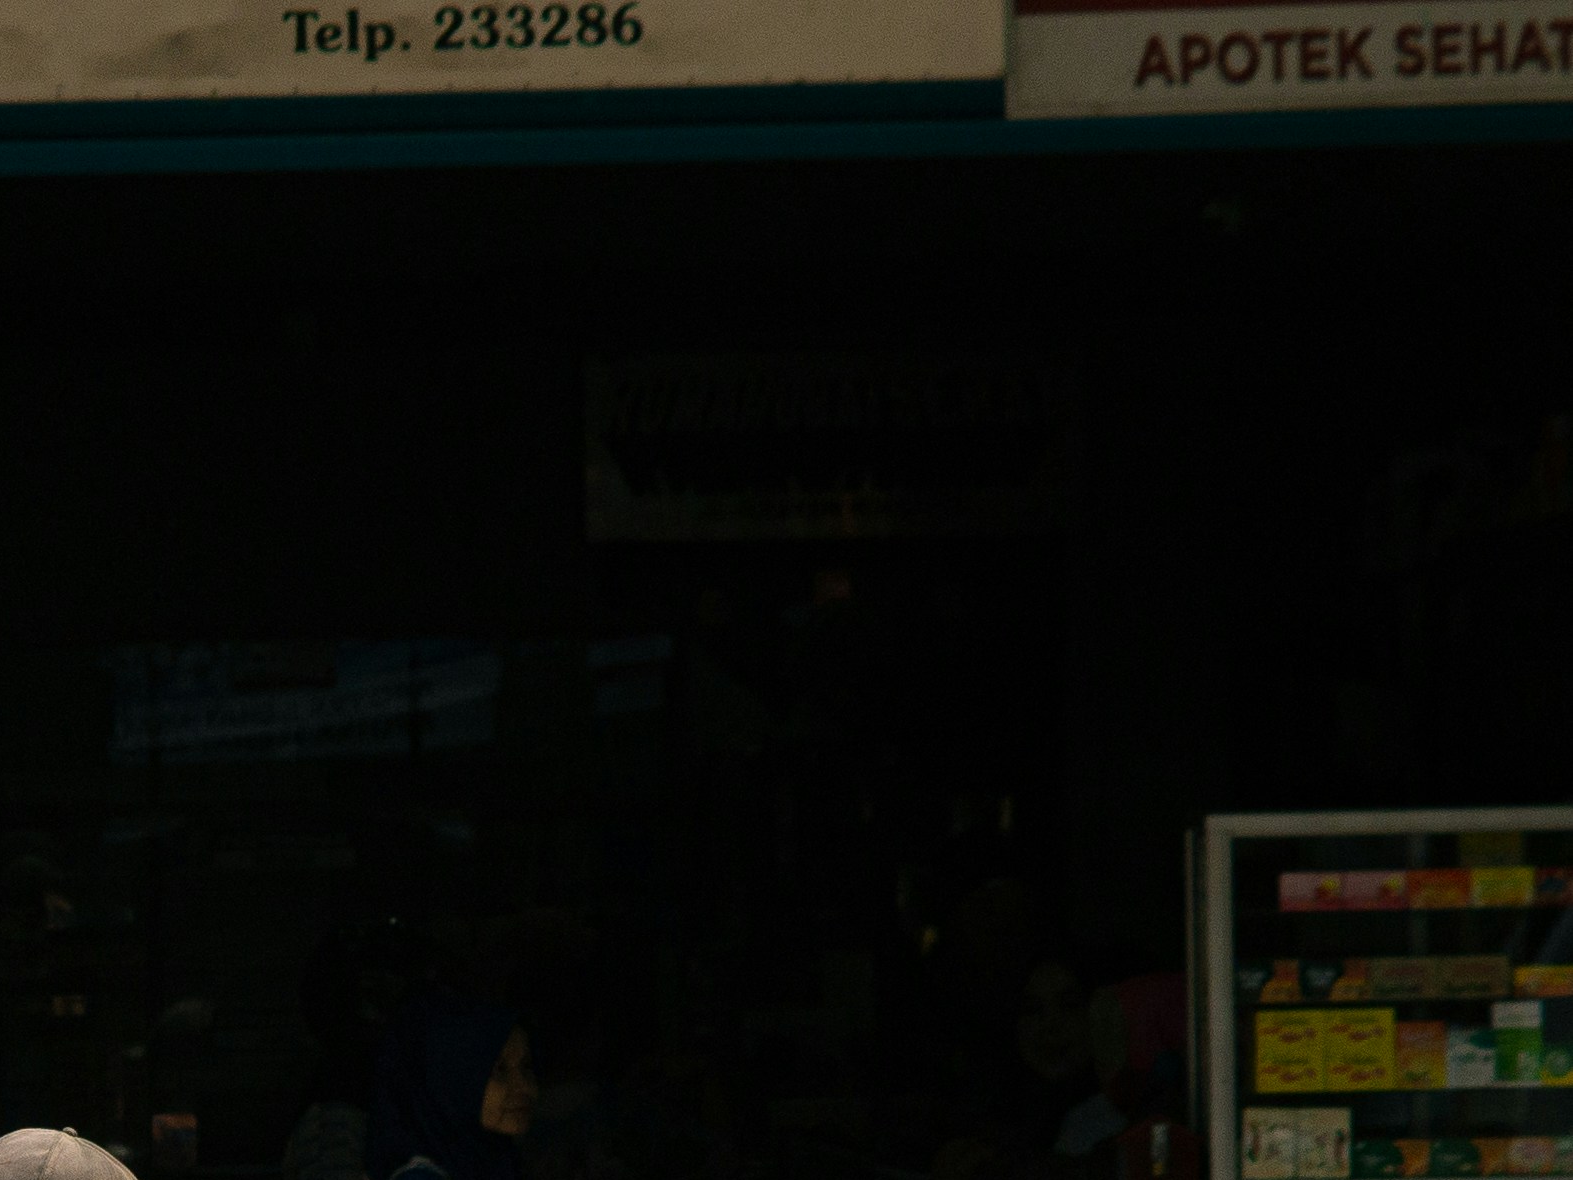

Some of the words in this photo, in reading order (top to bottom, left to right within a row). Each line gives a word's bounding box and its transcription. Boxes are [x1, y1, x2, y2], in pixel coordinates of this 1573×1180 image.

[282, 9, 410, 61] Telp.
[435, 4, 643, 50] 233286
[1135, 28, 1373, 87] APOTEK
[1395, 19, 1573, 78] SEHAT
